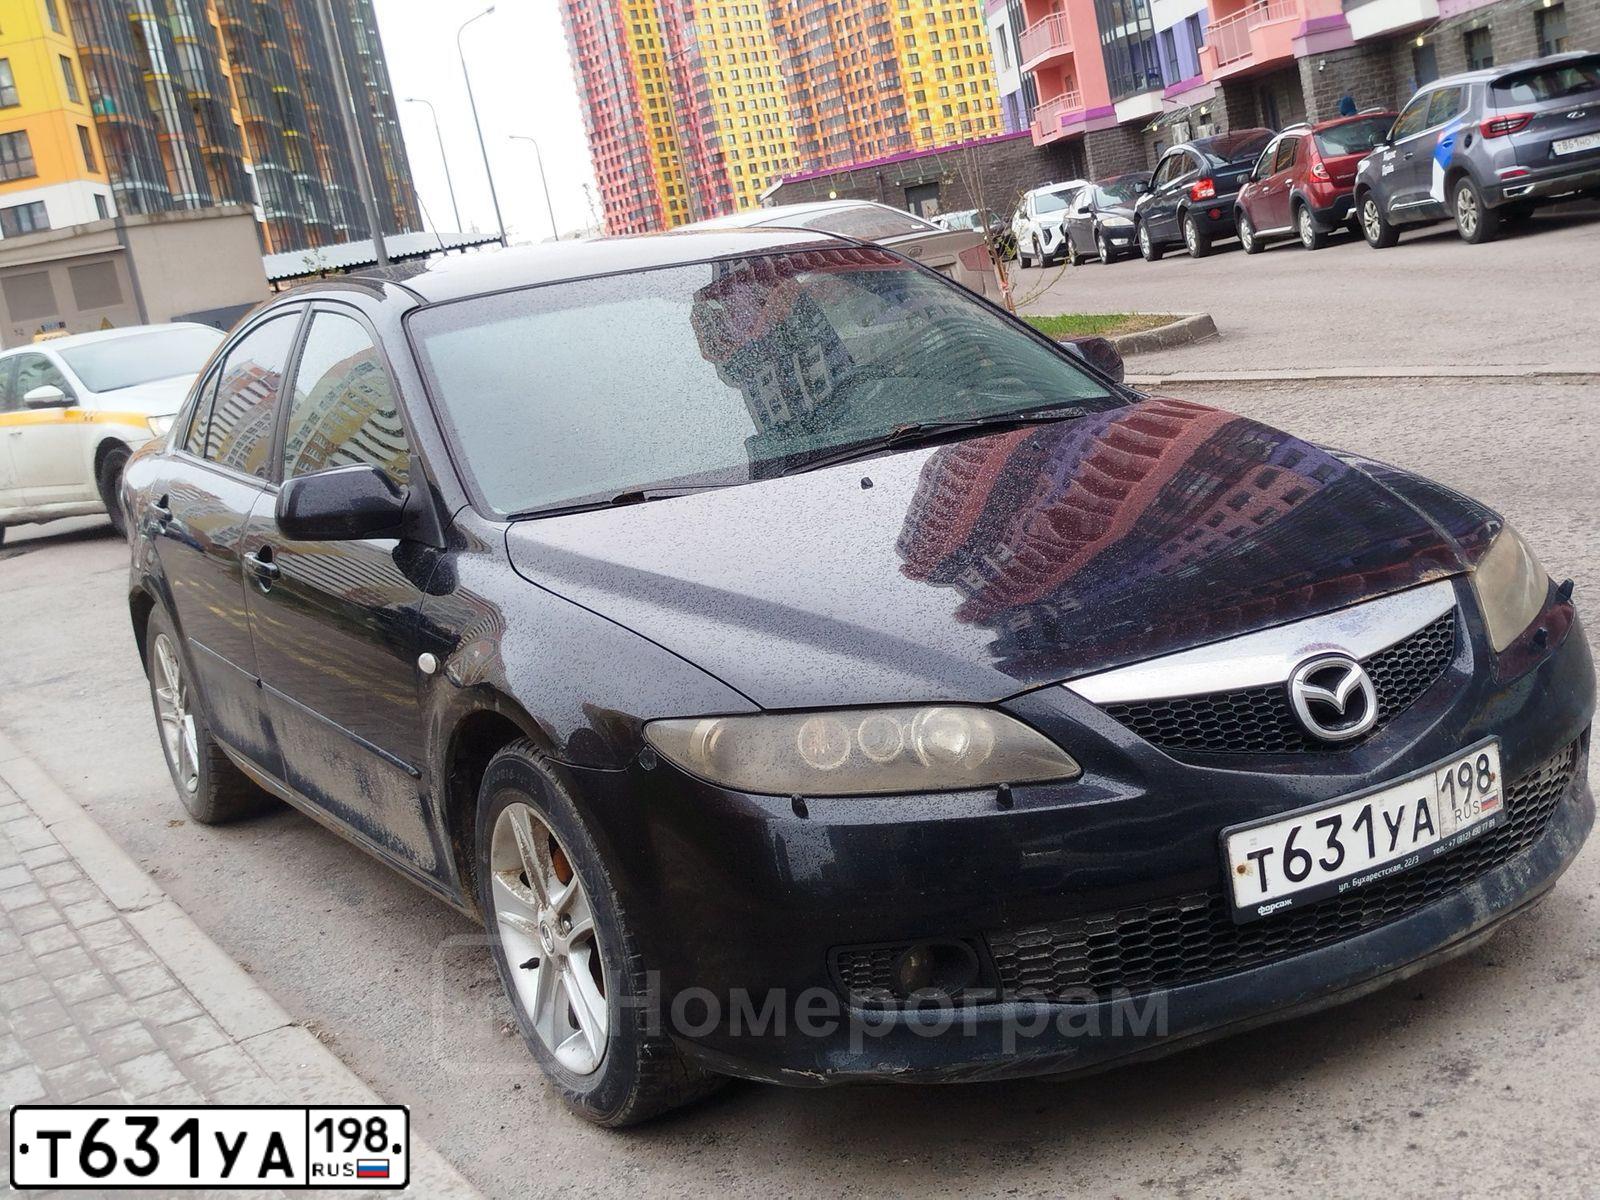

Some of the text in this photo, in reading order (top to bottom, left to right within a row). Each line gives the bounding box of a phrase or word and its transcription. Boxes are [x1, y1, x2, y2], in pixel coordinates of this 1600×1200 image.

[1247, 754, 1491, 892] Т631УА 198
[1454, 800, 1480, 824] RUS
[1338, 855, 1419, 893] ул. Бухарестская, 22/3
